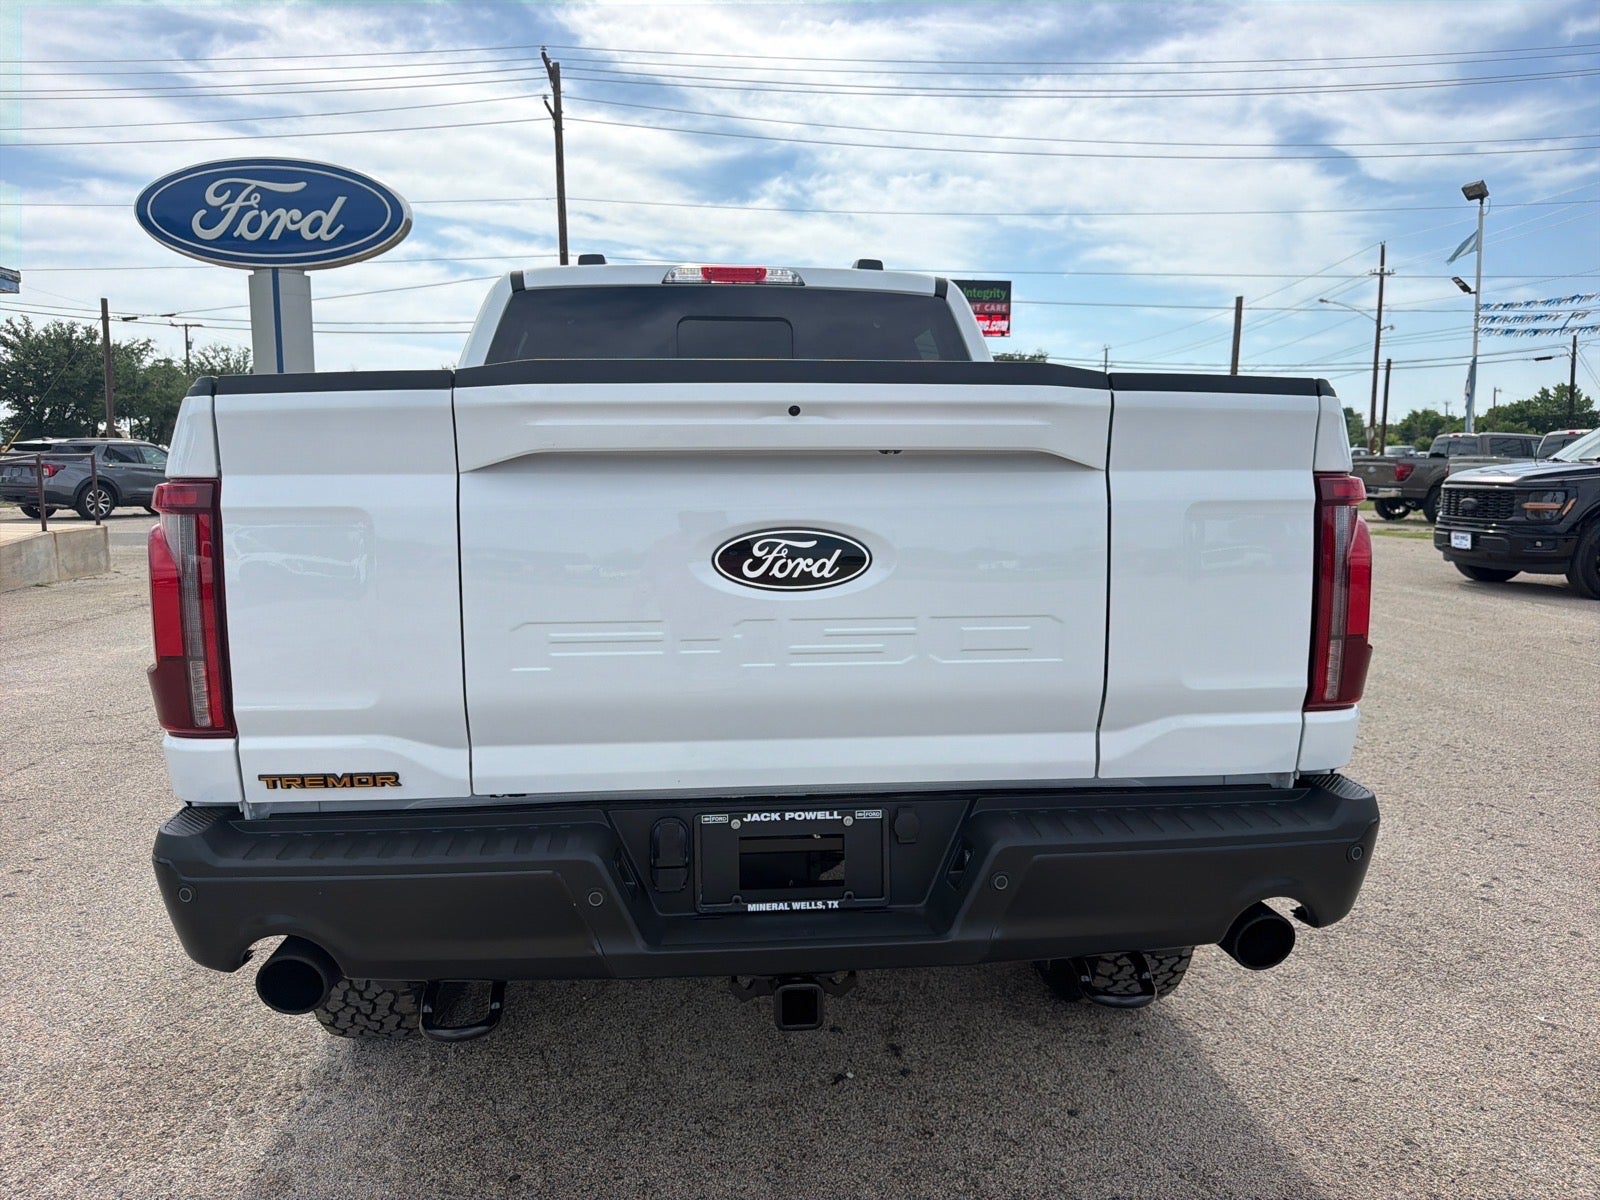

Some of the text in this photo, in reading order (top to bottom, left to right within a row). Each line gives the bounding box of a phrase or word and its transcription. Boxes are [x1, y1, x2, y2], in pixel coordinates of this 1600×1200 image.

[191, 177, 348, 241] Ford
[984, 303, 1007, 312] CARE
[742, 538, 842, 579] Ford
[510, 615, 1063, 671] F-150
[258, 772, 402, 790] TREMOR
[742, 810, 842, 822] JACK POWELL
[747, 900, 839, 912] MINERAL WELLS, TX
